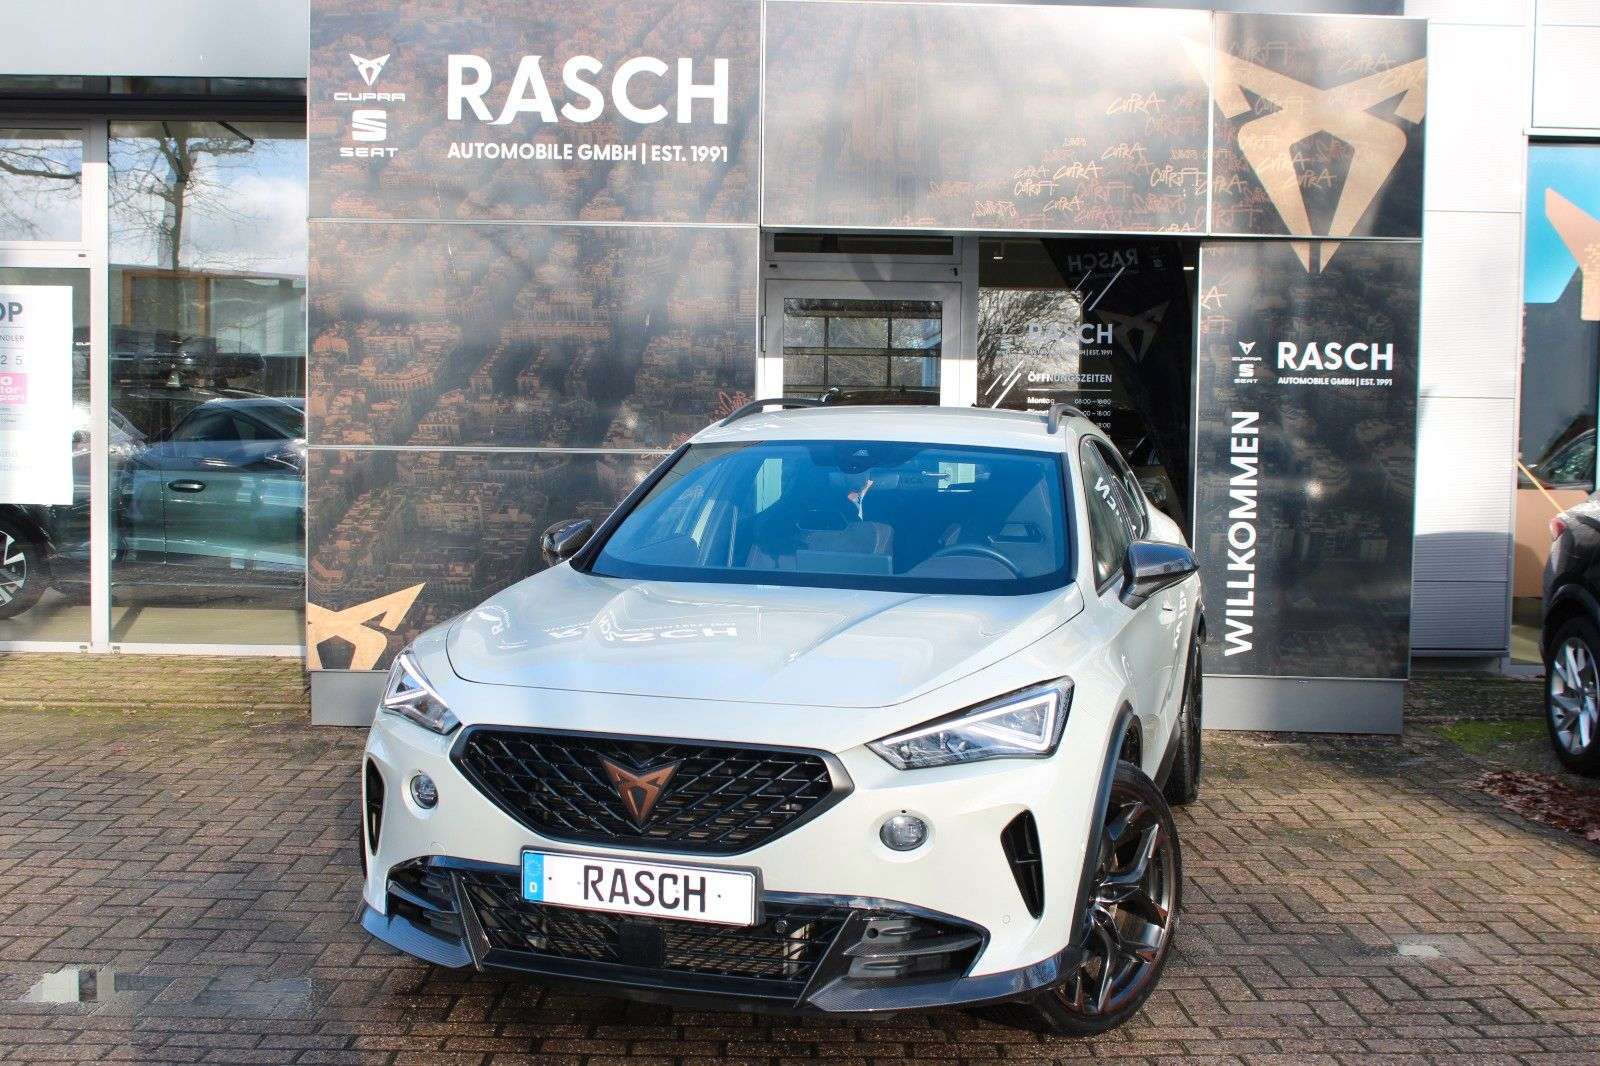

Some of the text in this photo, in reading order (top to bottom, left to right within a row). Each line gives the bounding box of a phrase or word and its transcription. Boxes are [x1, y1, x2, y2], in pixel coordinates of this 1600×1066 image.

[333, 92, 406, 101] CUPRA
[447, 54, 729, 125] RASCH
[339, 147, 399, 158] SEAT
[448, 142, 728, 163] AUTOMOBILE GMBH EST. 1991
[1278, 342, 1393, 370] RASCH
[1027, 372, 1113, 383] ÖFFNUNGSZEITEN
[1278, 377, 1329, 385] AUTOMOBILE
[1360, 378, 1375, 386] EST.
[1377, 379, 1393, 387] 1991
[1224, 411, 1260, 657] WILLKOMMEN
[529, 882, 538, 893] D
[583, 865, 706, 912] RASCH
